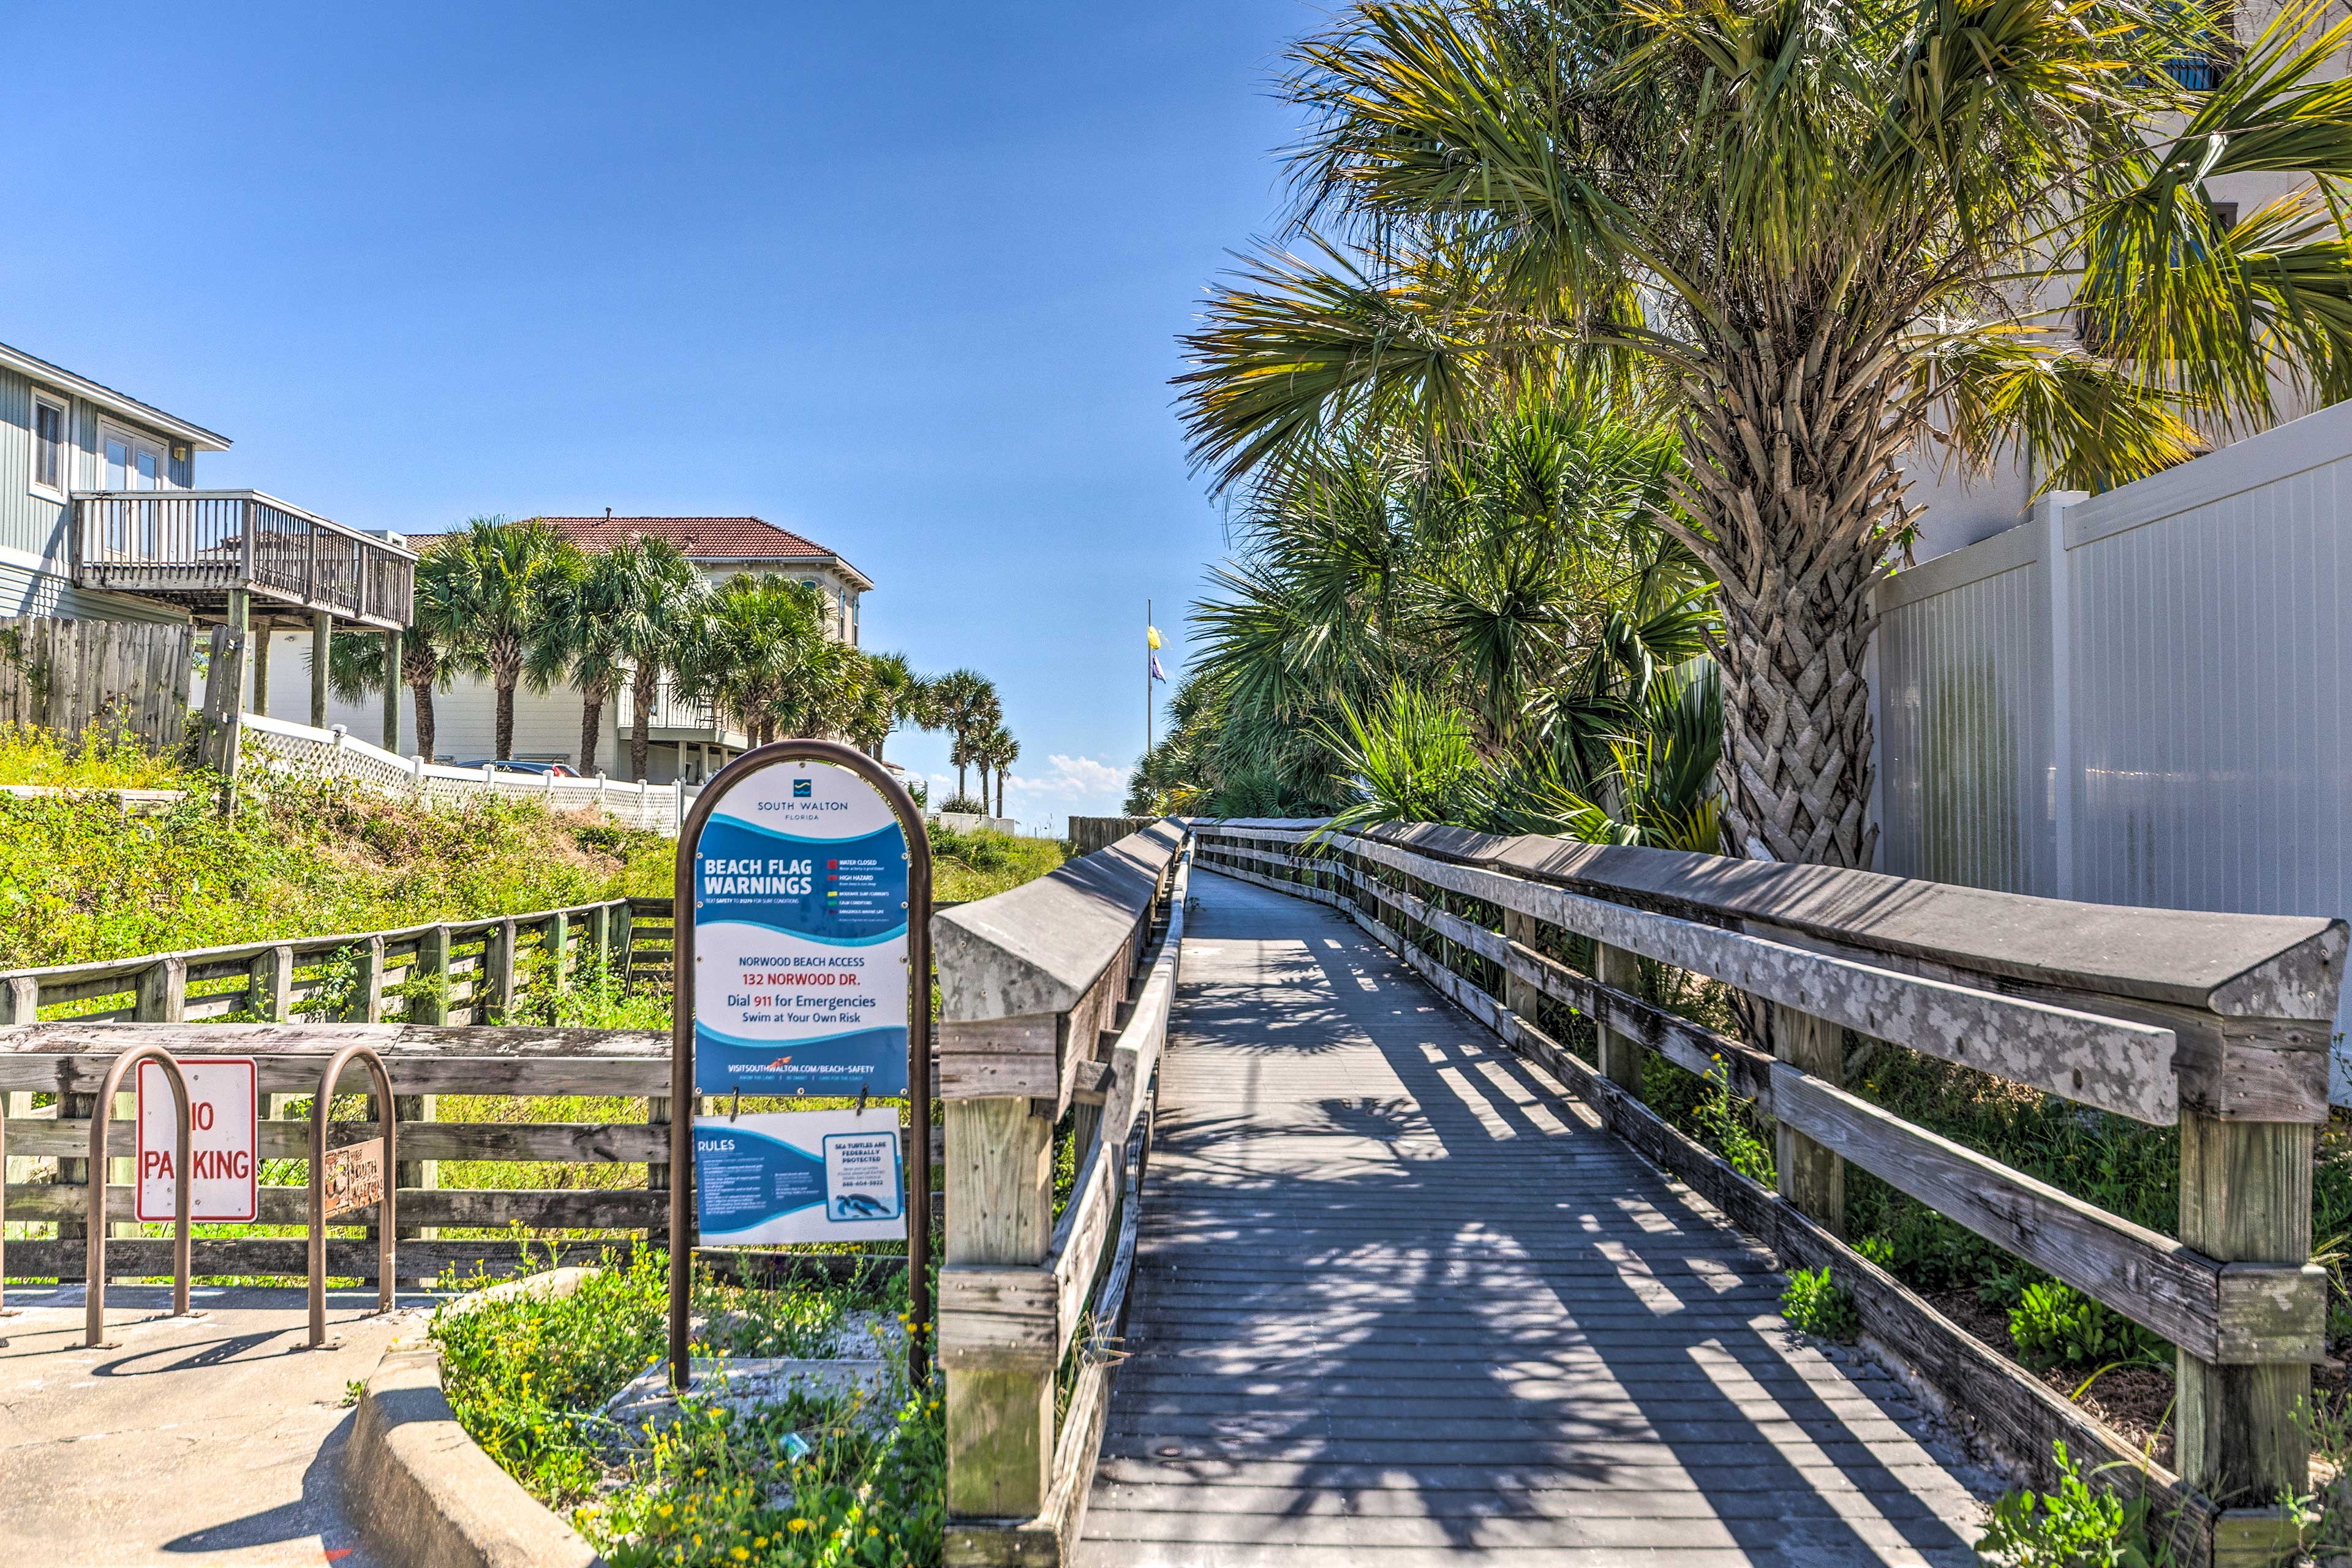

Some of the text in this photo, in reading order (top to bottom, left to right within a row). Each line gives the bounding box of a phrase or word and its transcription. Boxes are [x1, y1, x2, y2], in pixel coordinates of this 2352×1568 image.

[758, 802, 848, 810] SOUTH WALTON
[705, 859, 812, 875] BEACH FLAG
[704, 876, 812, 894] WARNINGS
[739, 957, 865, 967] NORWOOD BEACH ACCESS
[743, 973, 861, 986] 132 NORWOOD DR.
[728, 993, 876, 1011] Dial 911 for Emergencies
[742, 1012, 861, 1022] Swim at Your Own Risk
[728, 1064, 875, 1074] VISITSOUTHWALTON.COM/BEACH-SAFETY
[698, 1139, 735, 1152] RULES
[144, 1150, 249, 1179] PAKING
